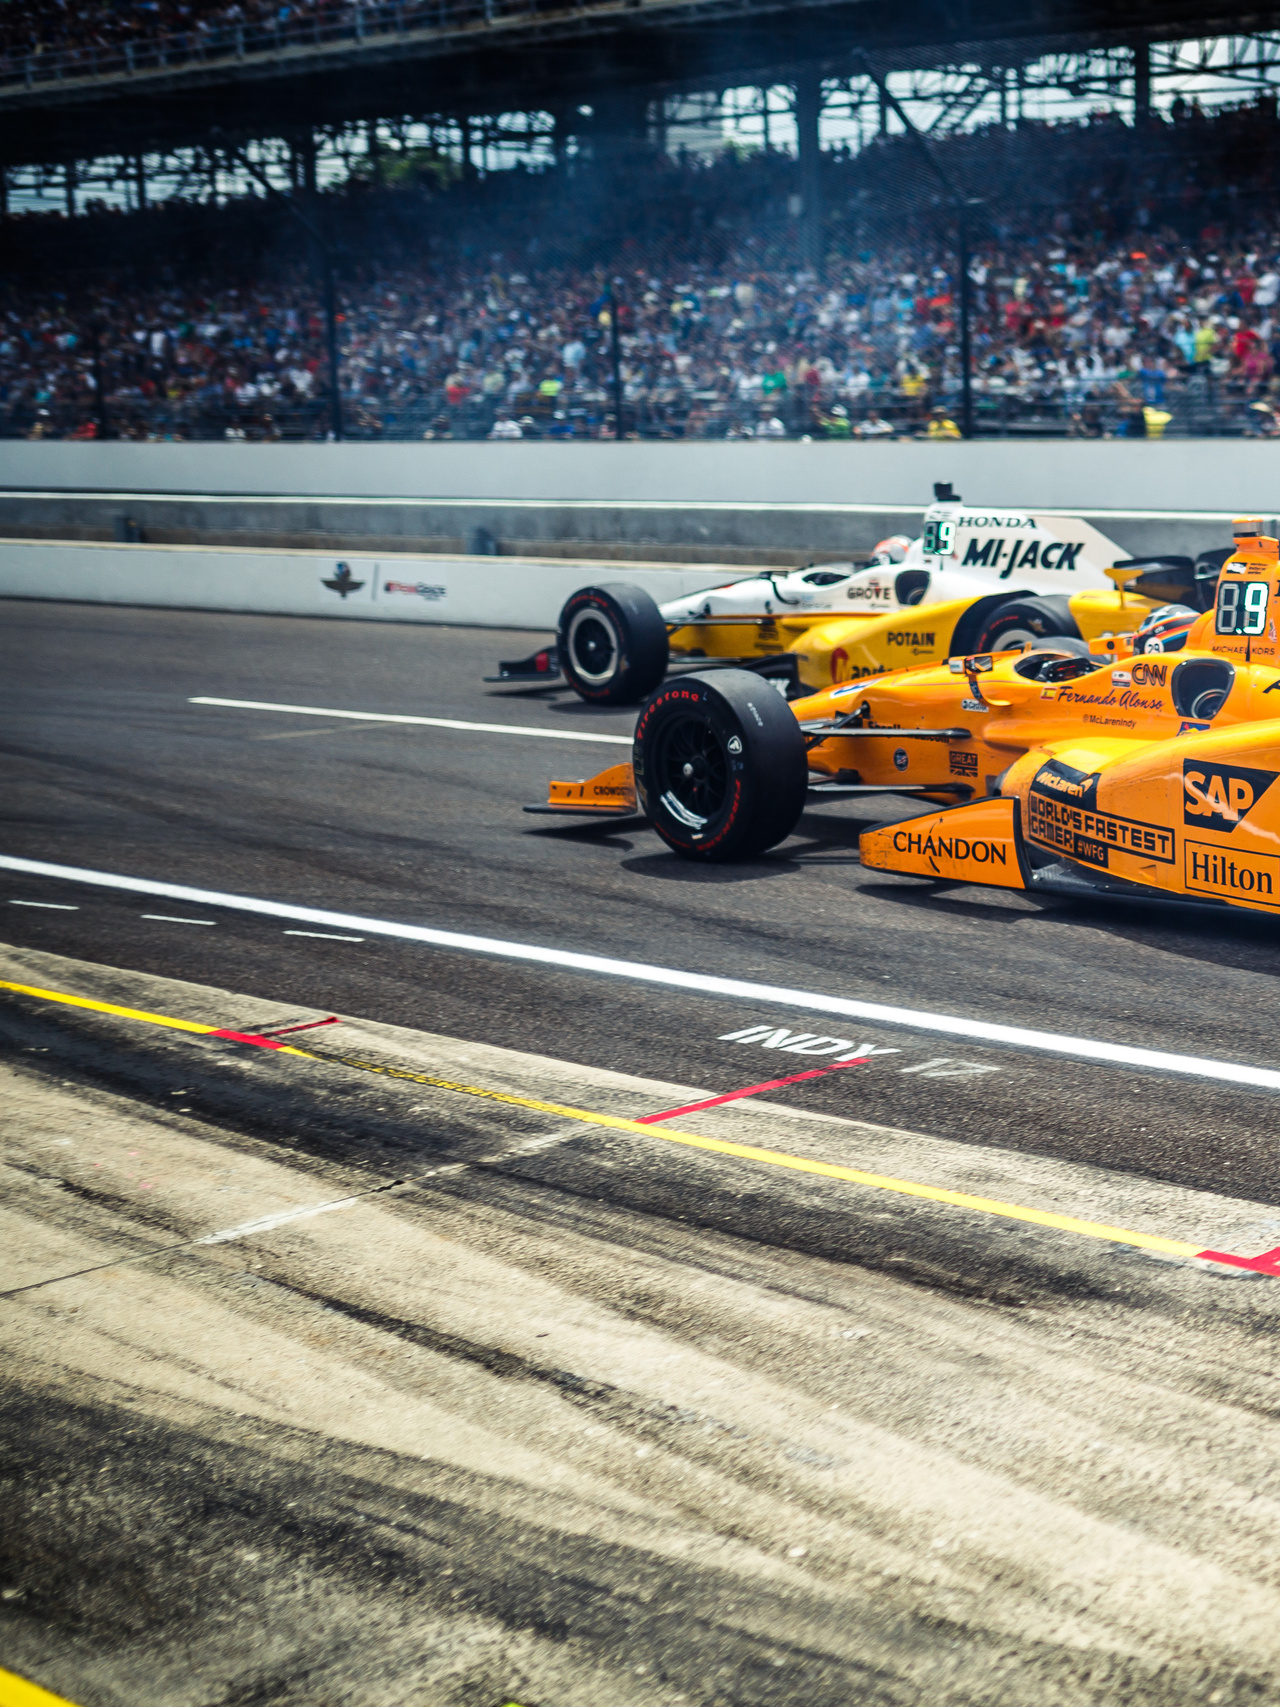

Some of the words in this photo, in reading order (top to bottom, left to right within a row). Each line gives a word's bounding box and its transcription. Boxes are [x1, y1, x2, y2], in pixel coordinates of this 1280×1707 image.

[958, 517, 1037, 529] HONDA
[847, 587, 891, 599] GROVE
[887, 632, 935, 646] POTAIN
[1252, 647, 1275, 655] KORS
[1132, 663, 1168, 687] CNN
[1058, 686, 1116, 705] Fernando
[1119, 690, 1166, 710] Alonso
[636, 690, 700, 740] Firestone
[1082, 714, 1137, 729] @McLarenIndy
[951, 753, 977, 765] GREAT
[1036, 772, 1083, 798] McLaren
[1184, 771, 1254, 821] SAP
[1031, 815, 1073, 849] GAMER
[1077, 840, 1104, 861] #WFG
[1085, 815, 1170, 854] FASTEST
[893, 831, 1006, 865] CHANDON
[1191, 852, 1274, 894] Hilton
[717, 1025, 902, 1062] INDY
